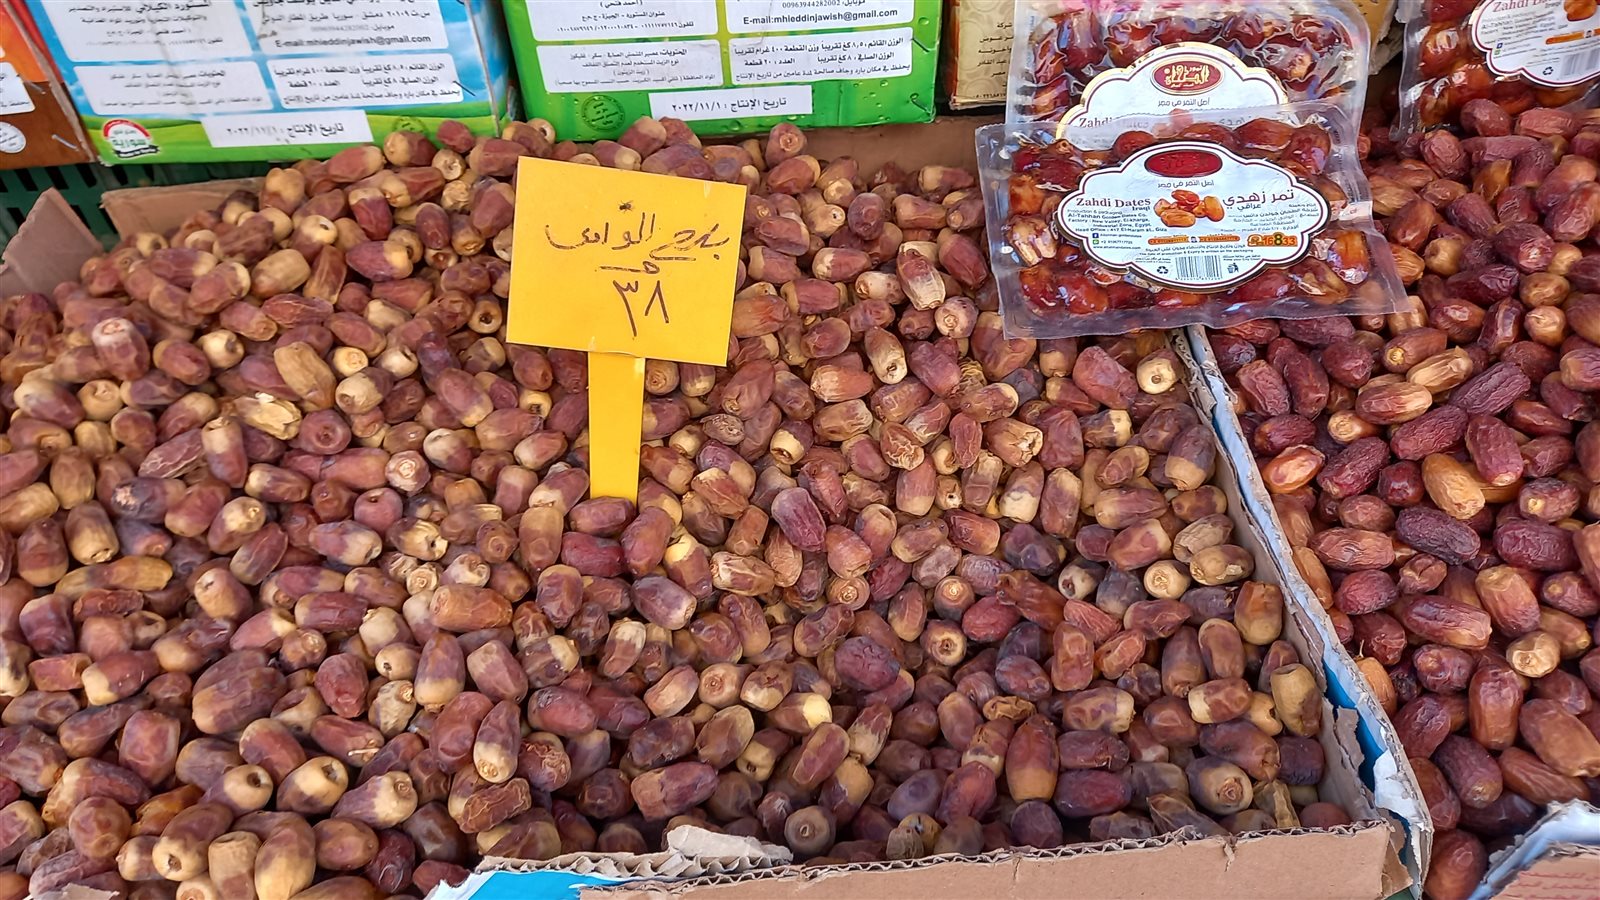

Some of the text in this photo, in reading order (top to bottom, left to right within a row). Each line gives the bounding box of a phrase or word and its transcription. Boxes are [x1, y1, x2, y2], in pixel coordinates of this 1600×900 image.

[887, 37, 904, 46] الوزن
[784, 44, 807, 52] القطعة
[878, 51, 895, 60] الوزن
[744, 58, 763, 66] قطعة
[814, 68, 835, 76] صالحة
[866, 66, 881, 74] مكان
[756, 71, 771, 80] تاريخ
[731, 98, 761, 113] الإنتاج
[763, 97, 787, 111] تاريخ
[320, 122, 344, 137] تاريخ
[1076, 197, 1151, 208] Zahdi Dates
[1222, 189, 1294, 210] تمر زهدي
[1237, 203, 1261, 211] عراقي
[649, 223, 730, 261] بلح
[1263, 233, 1296, 246] 16833
[612, 279, 669, 338] ٣٨
